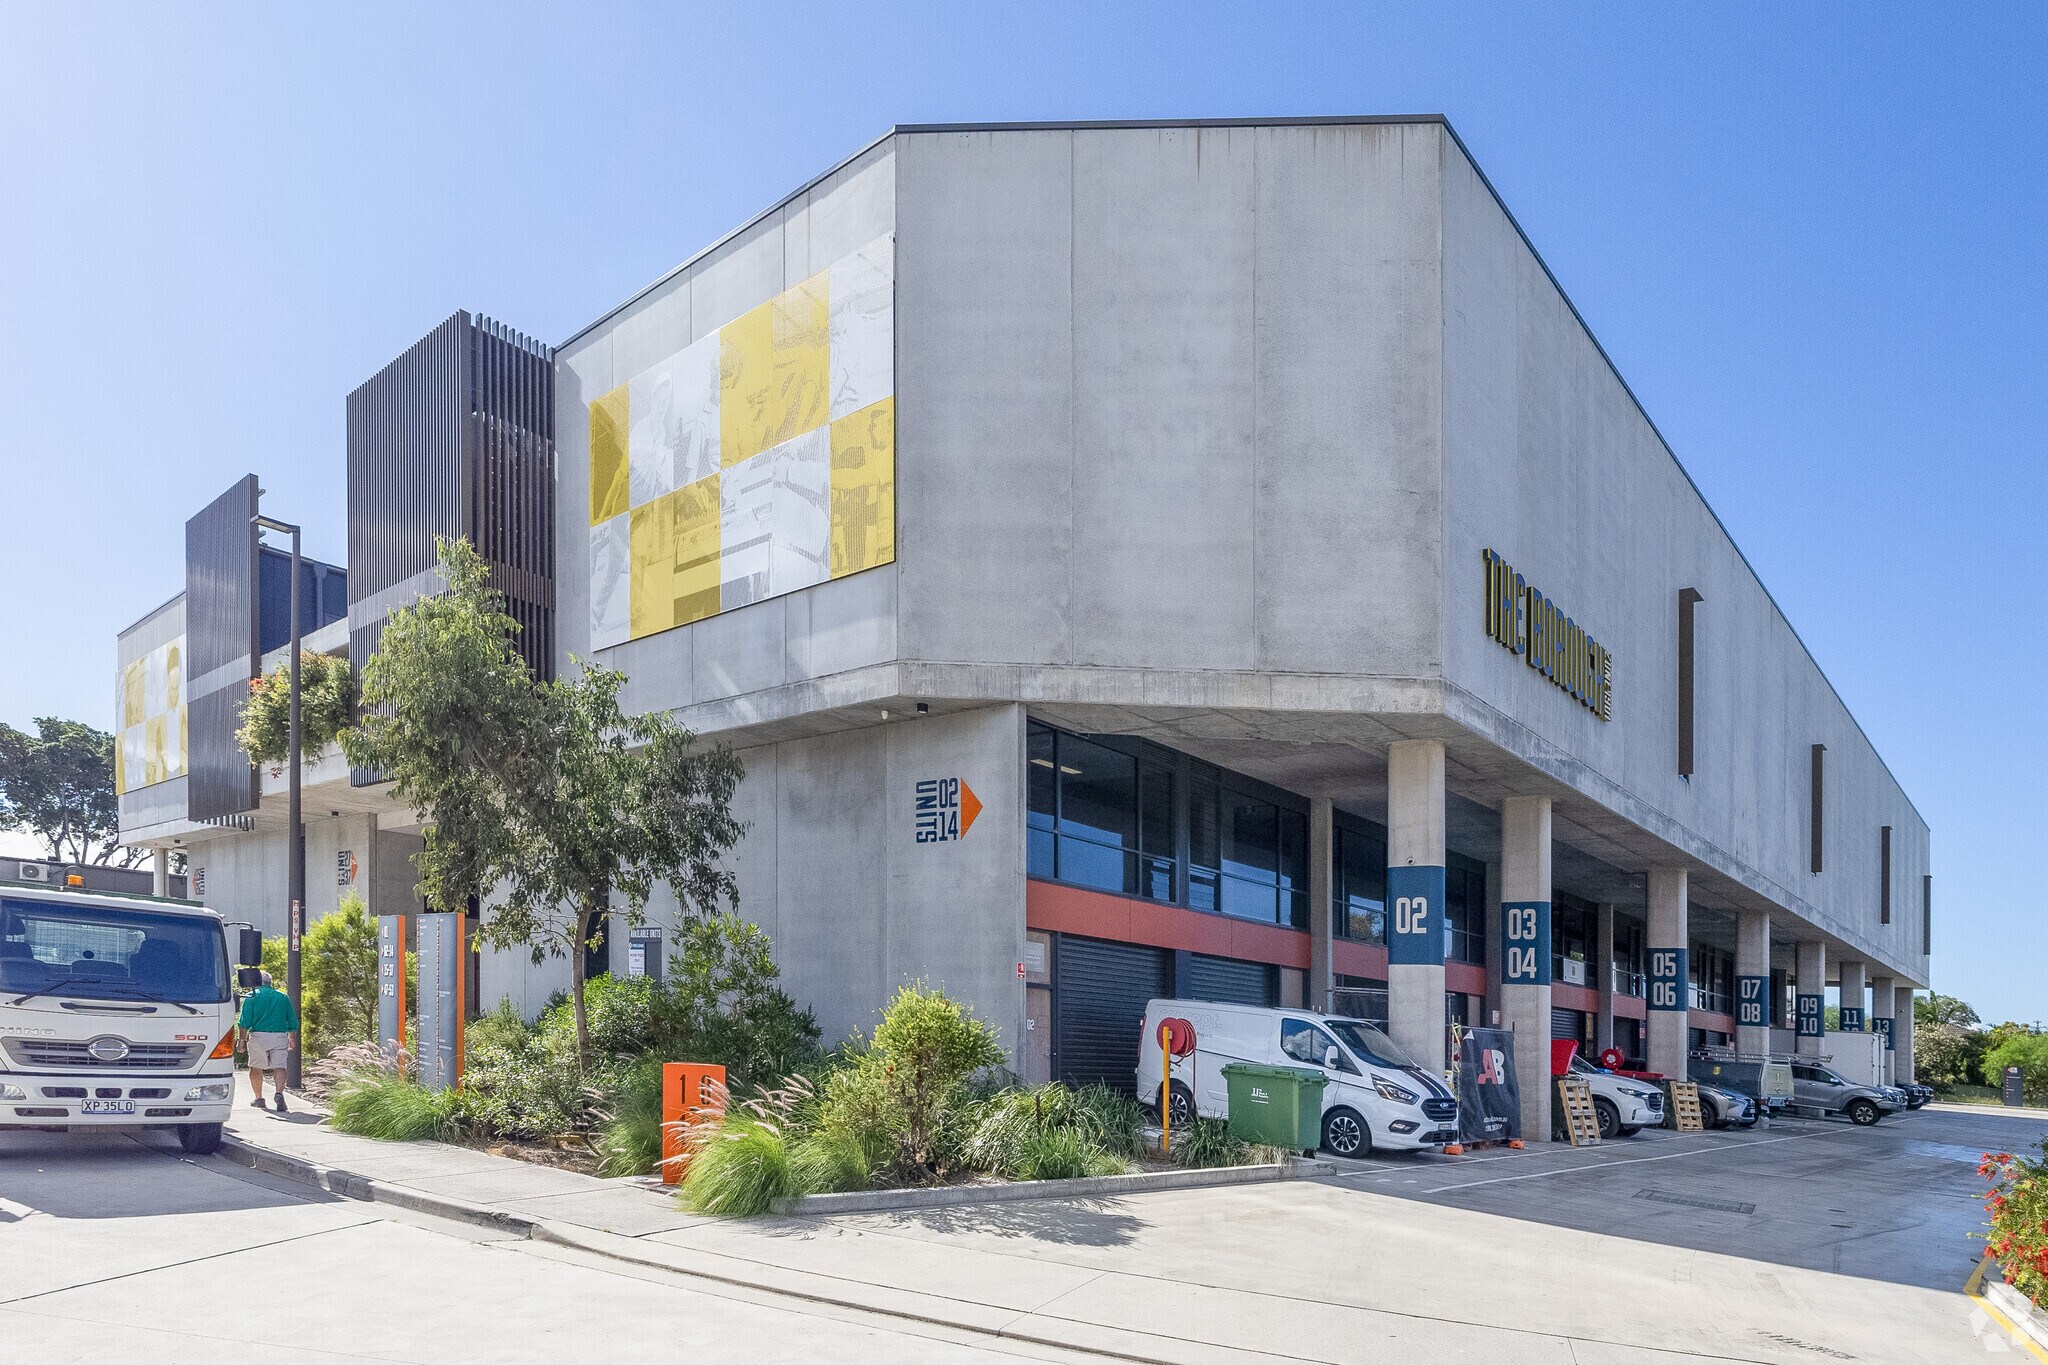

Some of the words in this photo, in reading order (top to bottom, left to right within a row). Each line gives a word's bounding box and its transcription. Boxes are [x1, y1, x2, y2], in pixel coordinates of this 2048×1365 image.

[1482, 547, 1526, 655] THE
[939, 777, 959, 809] 02
[915, 779, 938, 844] UNITS
[938, 810, 959, 842] 14
[337, 850, 346, 886] UNITS
[1395, 896, 1428, 935] 02
[1508, 908, 1537, 940] 03
[1508, 947, 1537, 979] 04
[1653, 952, 1676, 977] 05
[1653, 981, 1676, 1006] 06
[1741, 979, 1761, 999] 07
[1741, 1002, 1761, 1023] 08
[1800, 997, 1818, 1014] 09
[1843, 1010, 1859, 1025] 11
[0, 1026, 57, 1037] HINO
[1800, 1017, 1818, 1034] 10
[1875, 1019, 1890, 1033] 13
[1477, 1048, 1505, 1085] AB
